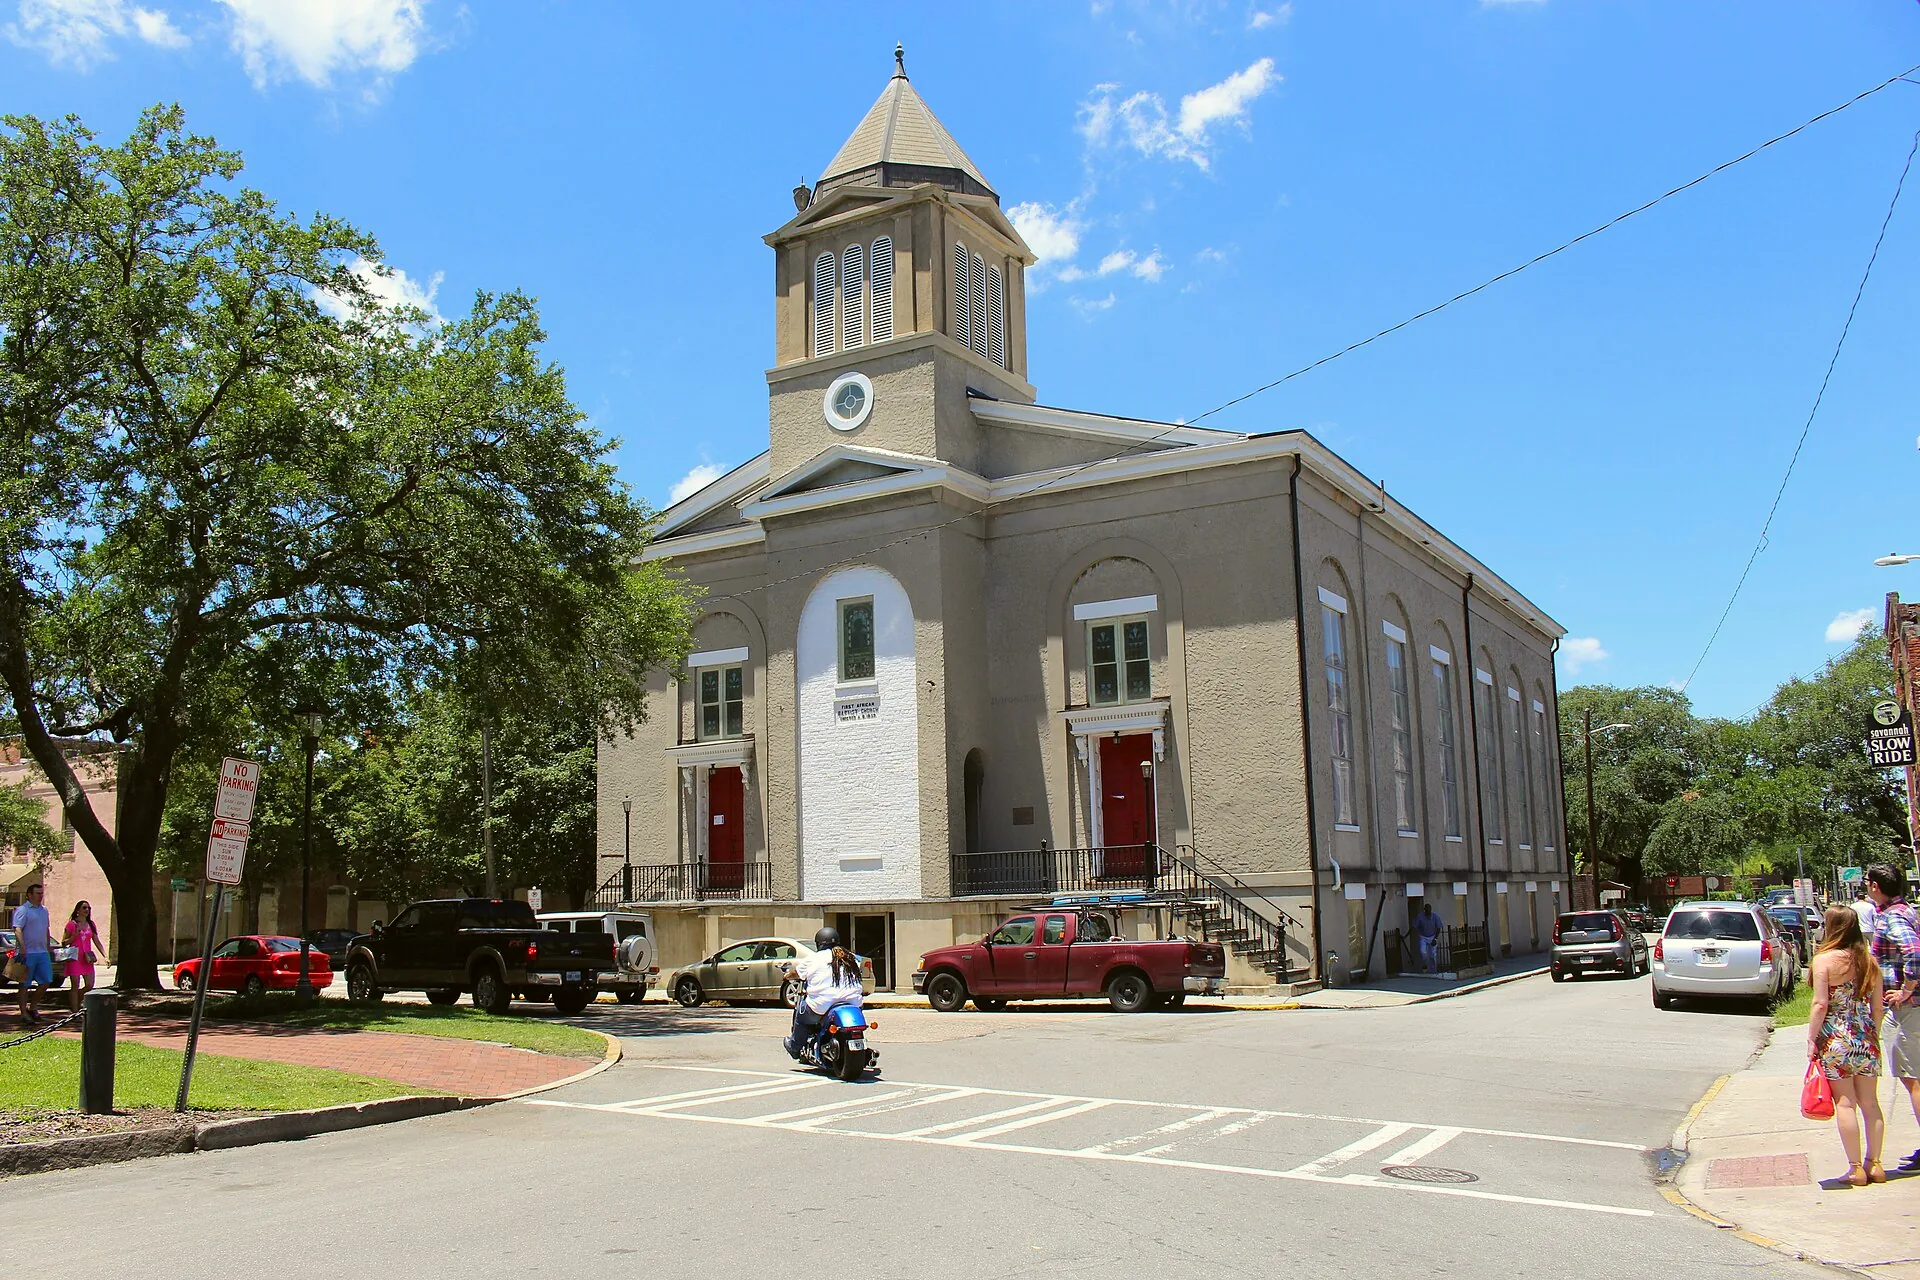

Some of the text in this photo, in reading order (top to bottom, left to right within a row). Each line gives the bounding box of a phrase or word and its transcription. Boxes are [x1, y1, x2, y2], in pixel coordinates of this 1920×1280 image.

[1870, 723, 1909, 738] savannah
[1870, 737, 1911, 752] SLOW
[1873, 749, 1912, 764] RIDE
[233, 764, 248, 777] NO
[222, 776, 254, 792] PARKING
[213, 823, 248, 838] NO PARKING
